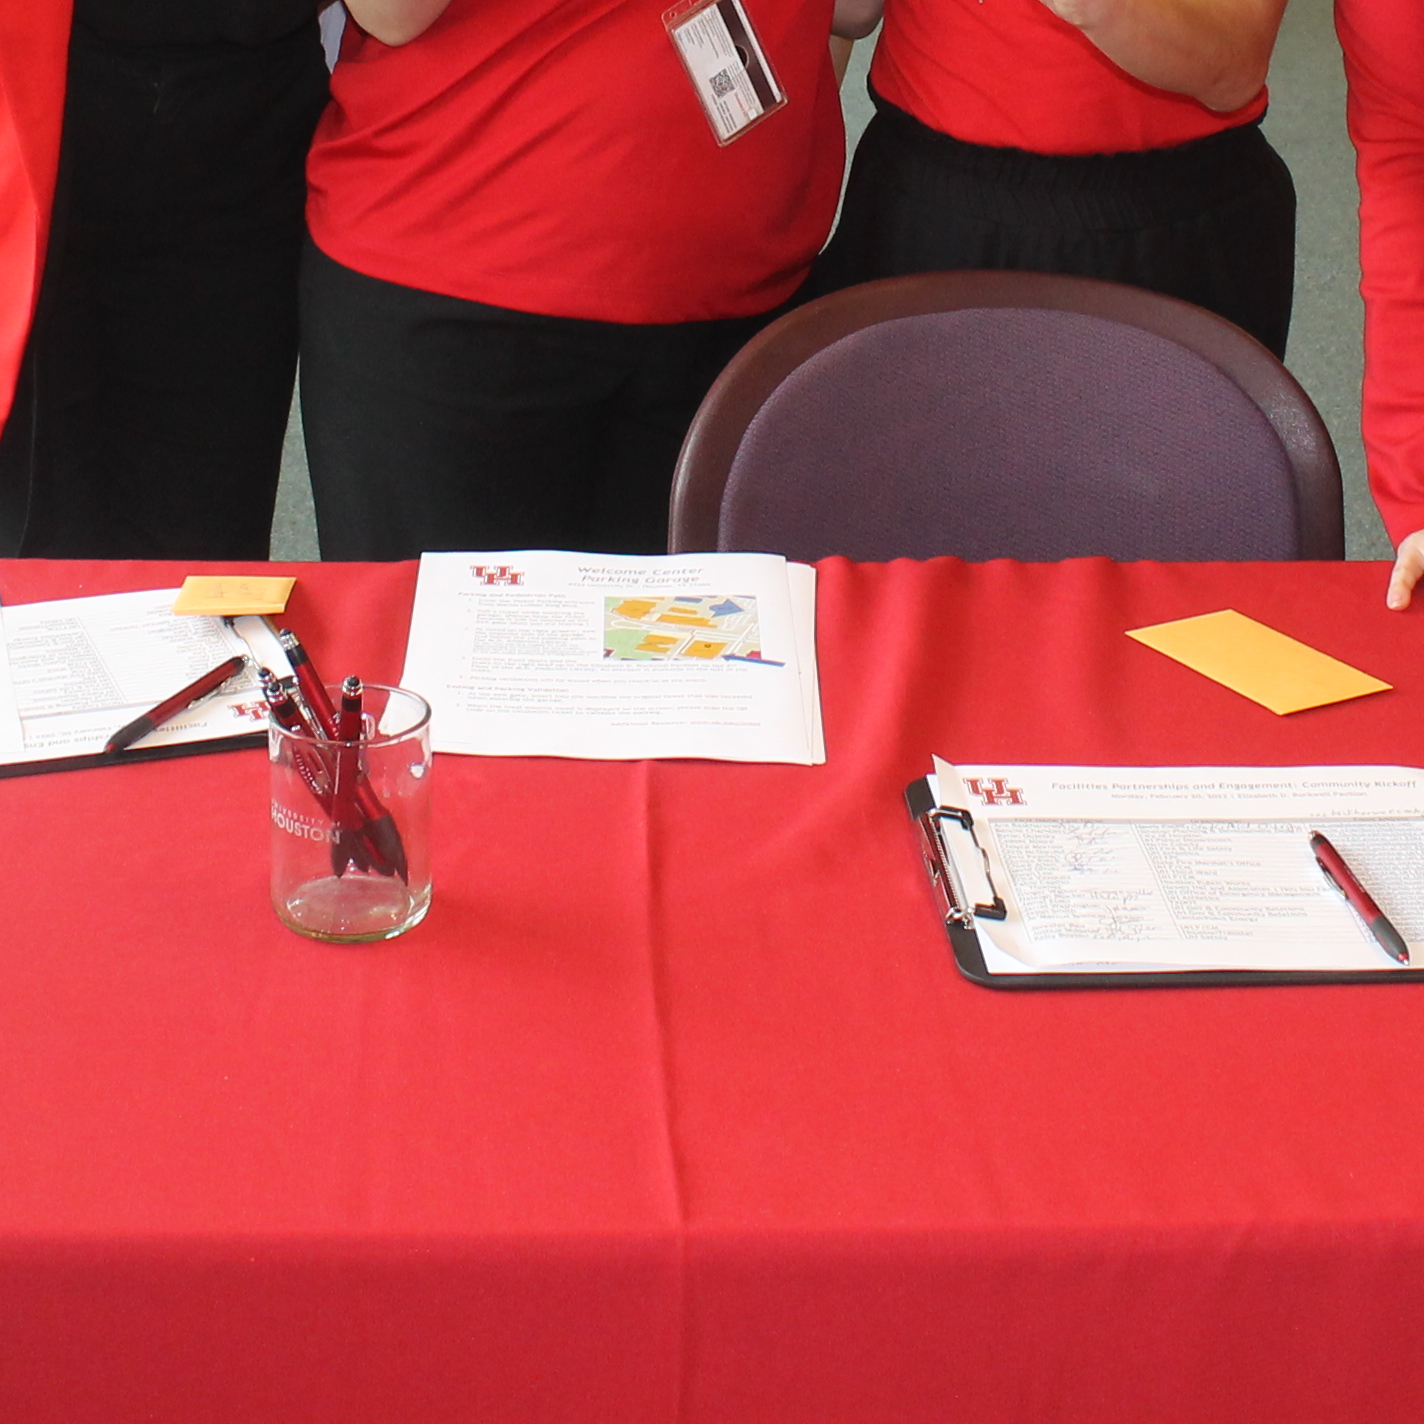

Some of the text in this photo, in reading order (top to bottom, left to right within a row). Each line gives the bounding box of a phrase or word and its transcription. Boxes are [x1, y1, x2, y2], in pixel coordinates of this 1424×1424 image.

[470, 565, 525, 586] UH
[577, 566, 705, 576] Welcome Center
[581, 575, 639, 585] Parking
[645, 576, 700, 585] Garage
[963, 777, 1029, 806] UH
[1051, 781, 1108, 791] Facilities
[1111, 781, 1189, 792] Partnerships
[1193, 781, 1215, 791] and
[1301, 780, 1373, 791] Community
[1374, 779, 1418, 790] Kickoff
[271, 806, 341, 844] HOUSTON
